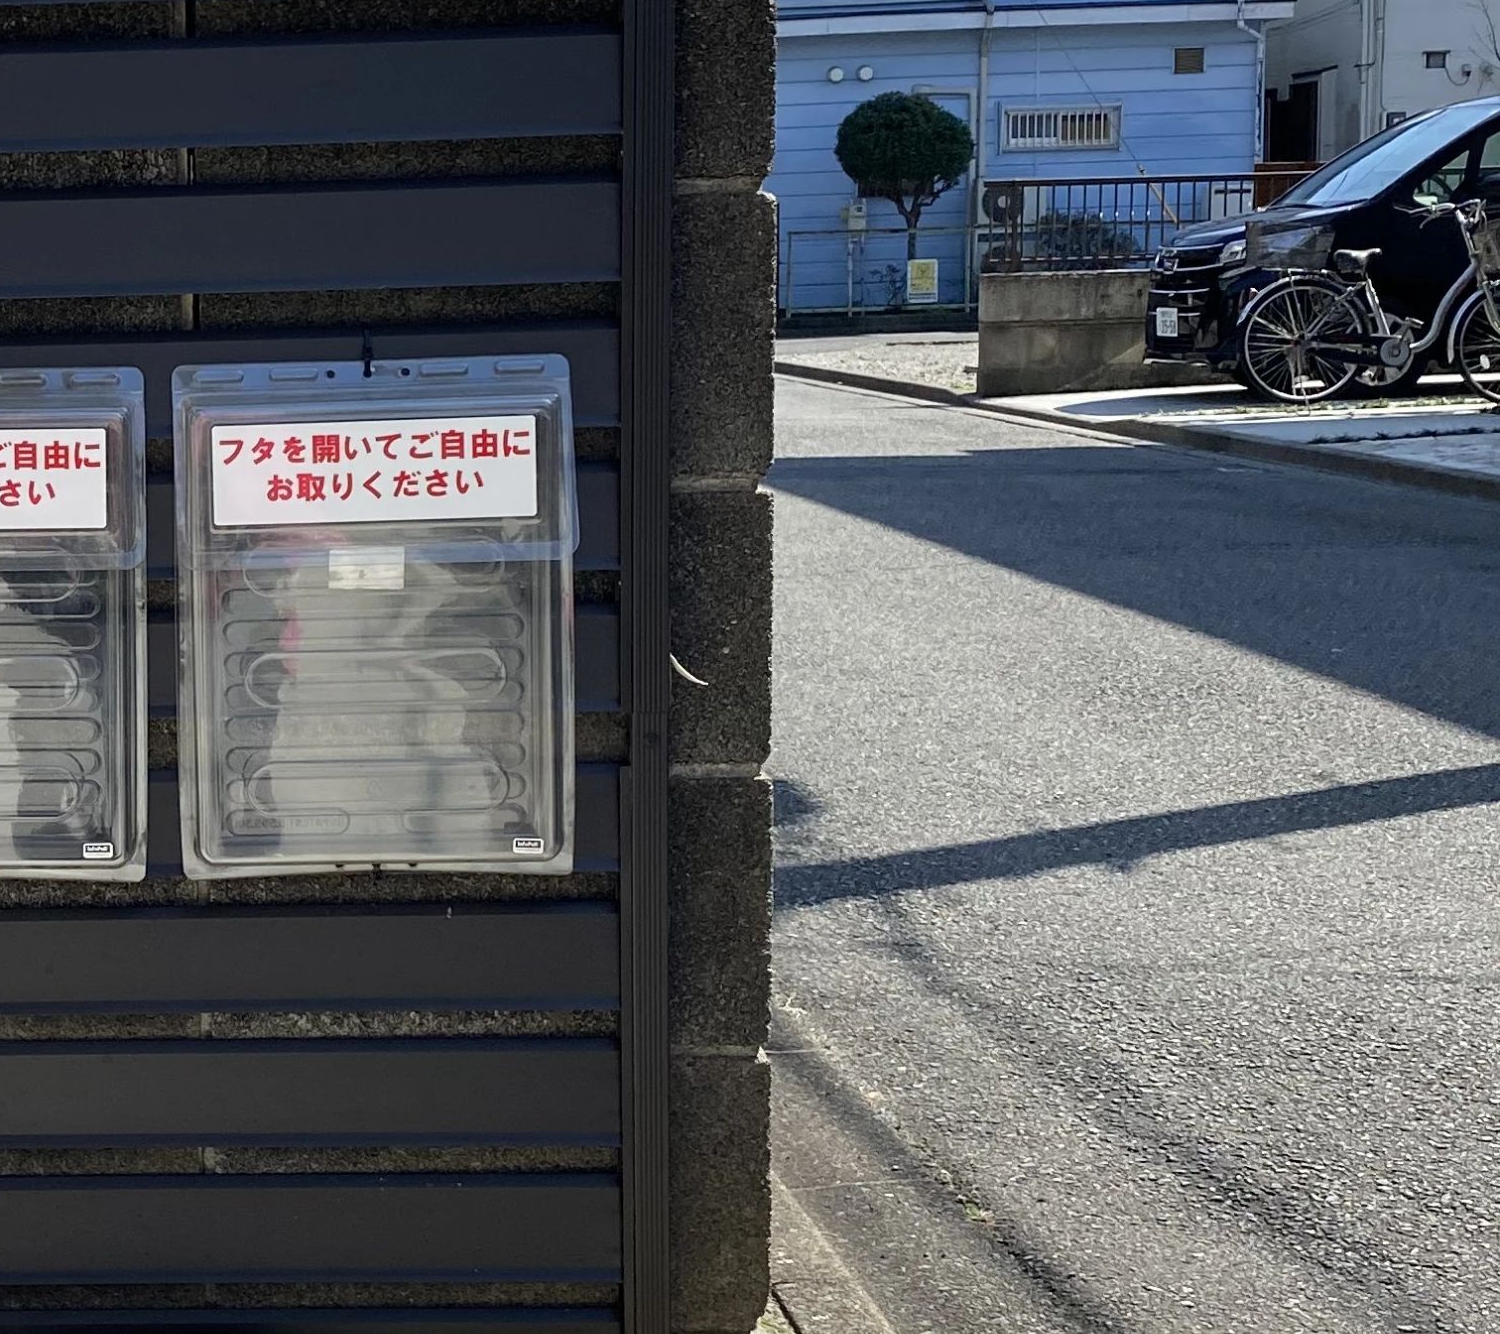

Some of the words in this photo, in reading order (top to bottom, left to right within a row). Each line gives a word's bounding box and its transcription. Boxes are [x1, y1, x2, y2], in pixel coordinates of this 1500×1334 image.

[219, 428, 530, 465] フタを開いてご自由に
[266, 468, 484, 502] お取りください
